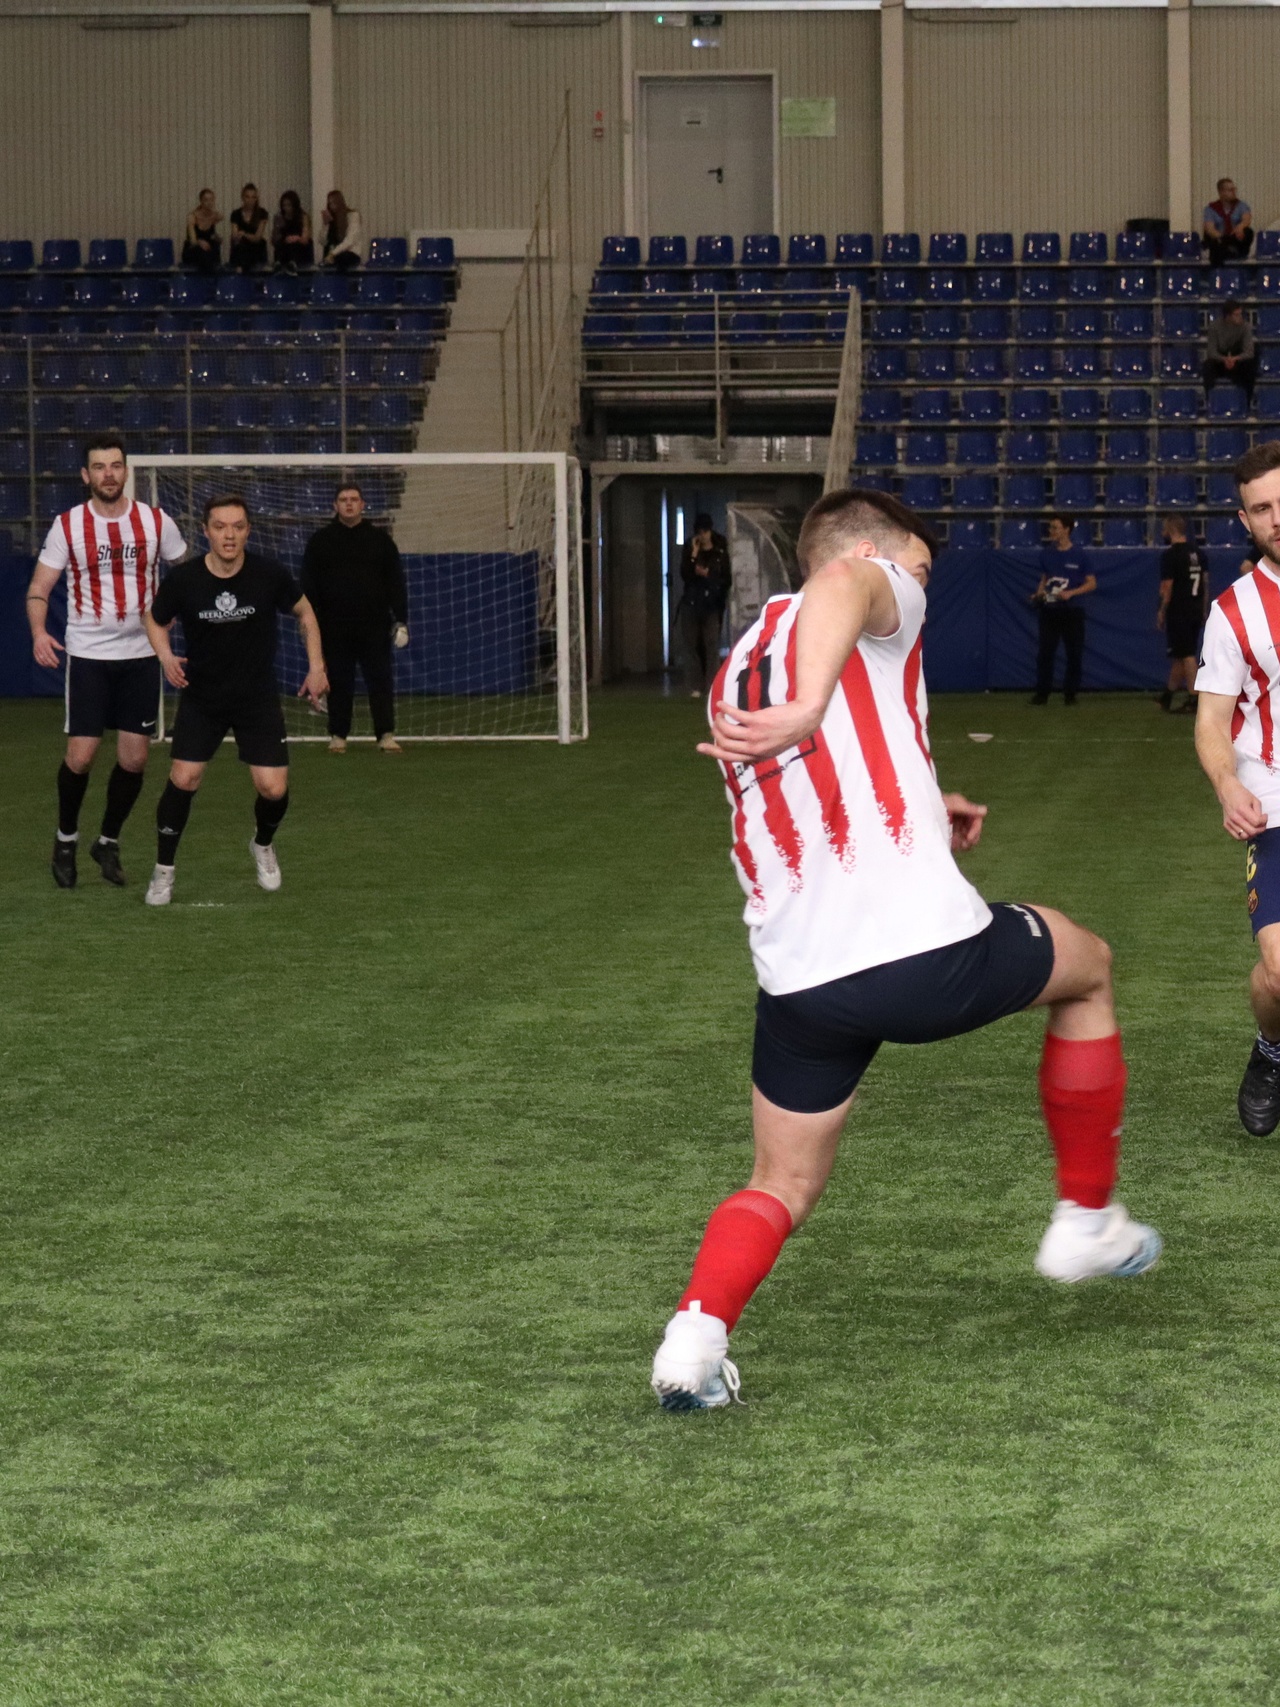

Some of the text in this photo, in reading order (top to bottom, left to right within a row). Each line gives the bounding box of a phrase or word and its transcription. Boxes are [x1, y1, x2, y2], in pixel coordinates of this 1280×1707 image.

[97, 543, 145, 561] Shelter
[1190, 572, 1201, 597] 7
[198, 606, 256, 620] BEERLOGOVO
